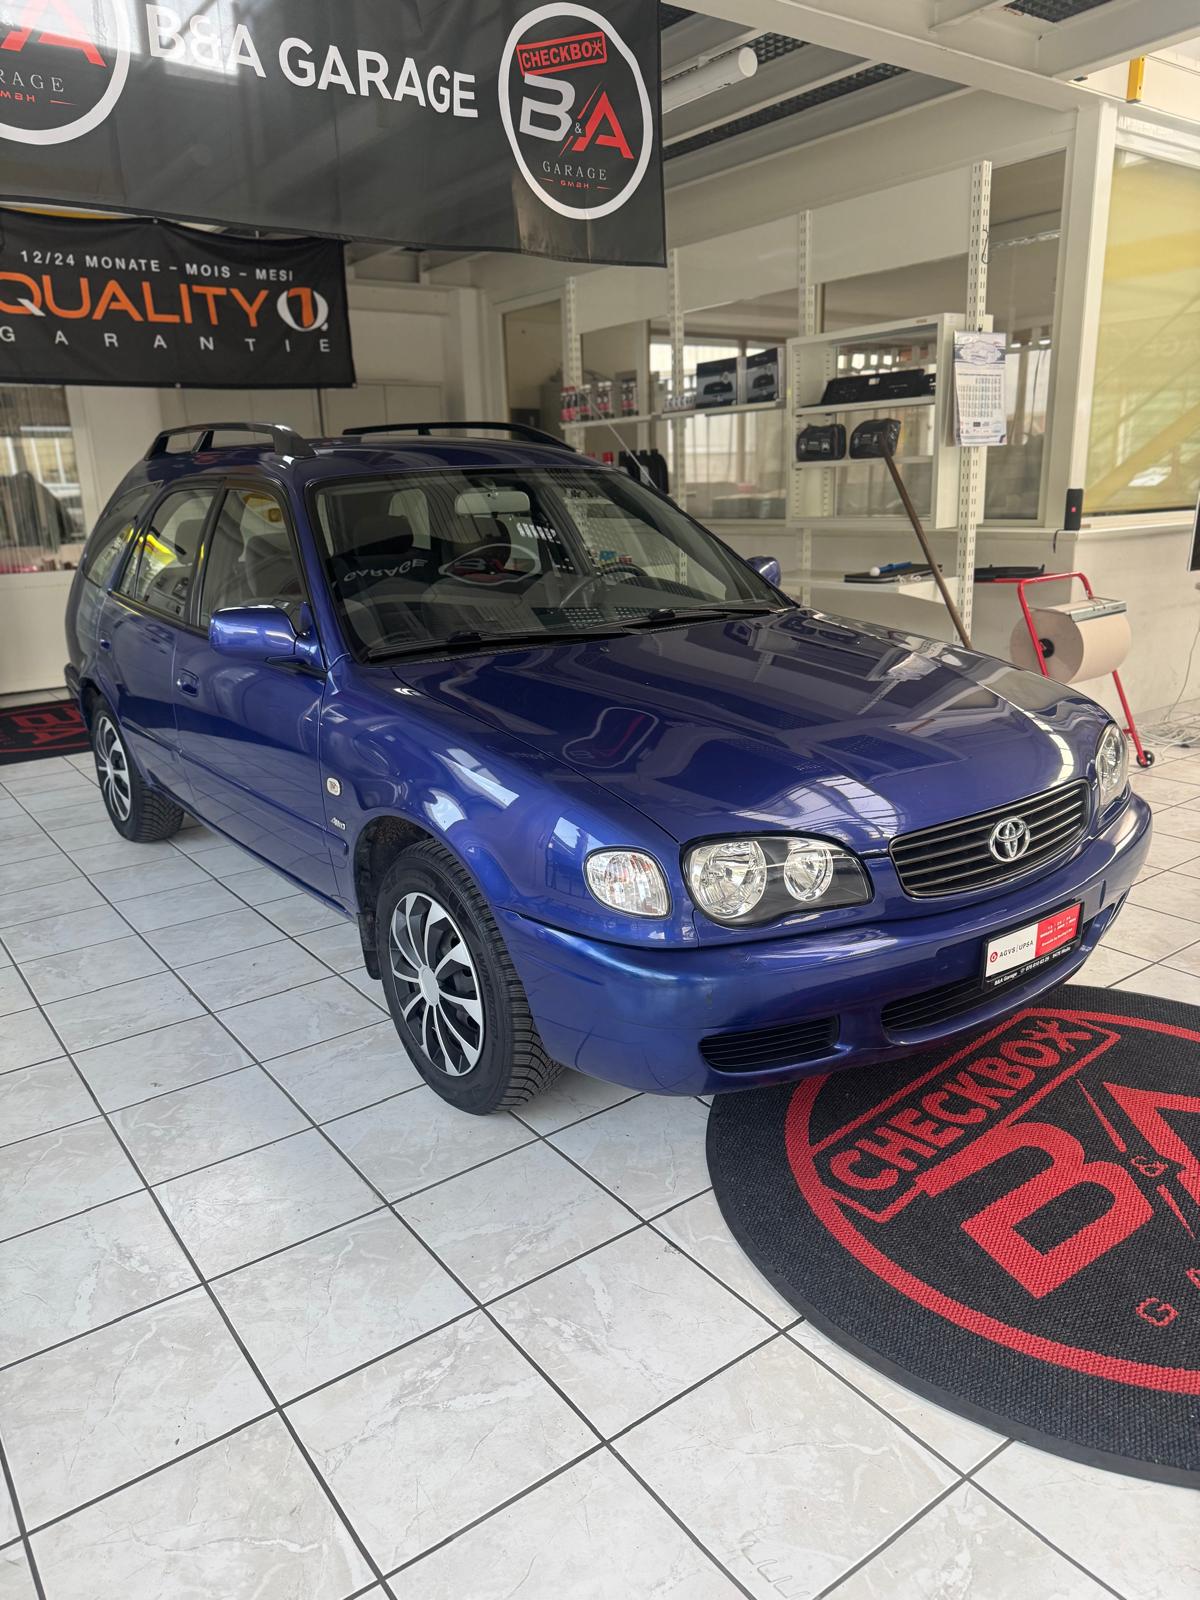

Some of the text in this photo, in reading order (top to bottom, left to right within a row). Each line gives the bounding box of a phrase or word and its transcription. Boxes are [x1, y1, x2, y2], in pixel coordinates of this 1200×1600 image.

[146, 4, 478, 118] B&A GARAGE
[521, 39, 603, 70] CHECKBOX
[542, 160, 607, 181] GARAGE
[20, 250, 76, 268] 12/24
[86, 255, 161, 272] MONATE
[185, 263, 231, 279] MOIS
[255, 268, 294, 282] MESI
[0, 271, 269, 328] QUALITY
[999, 940, 1034, 958] AGVS UPSA
[829, 1019, 1093, 1190] CHECKBOX
